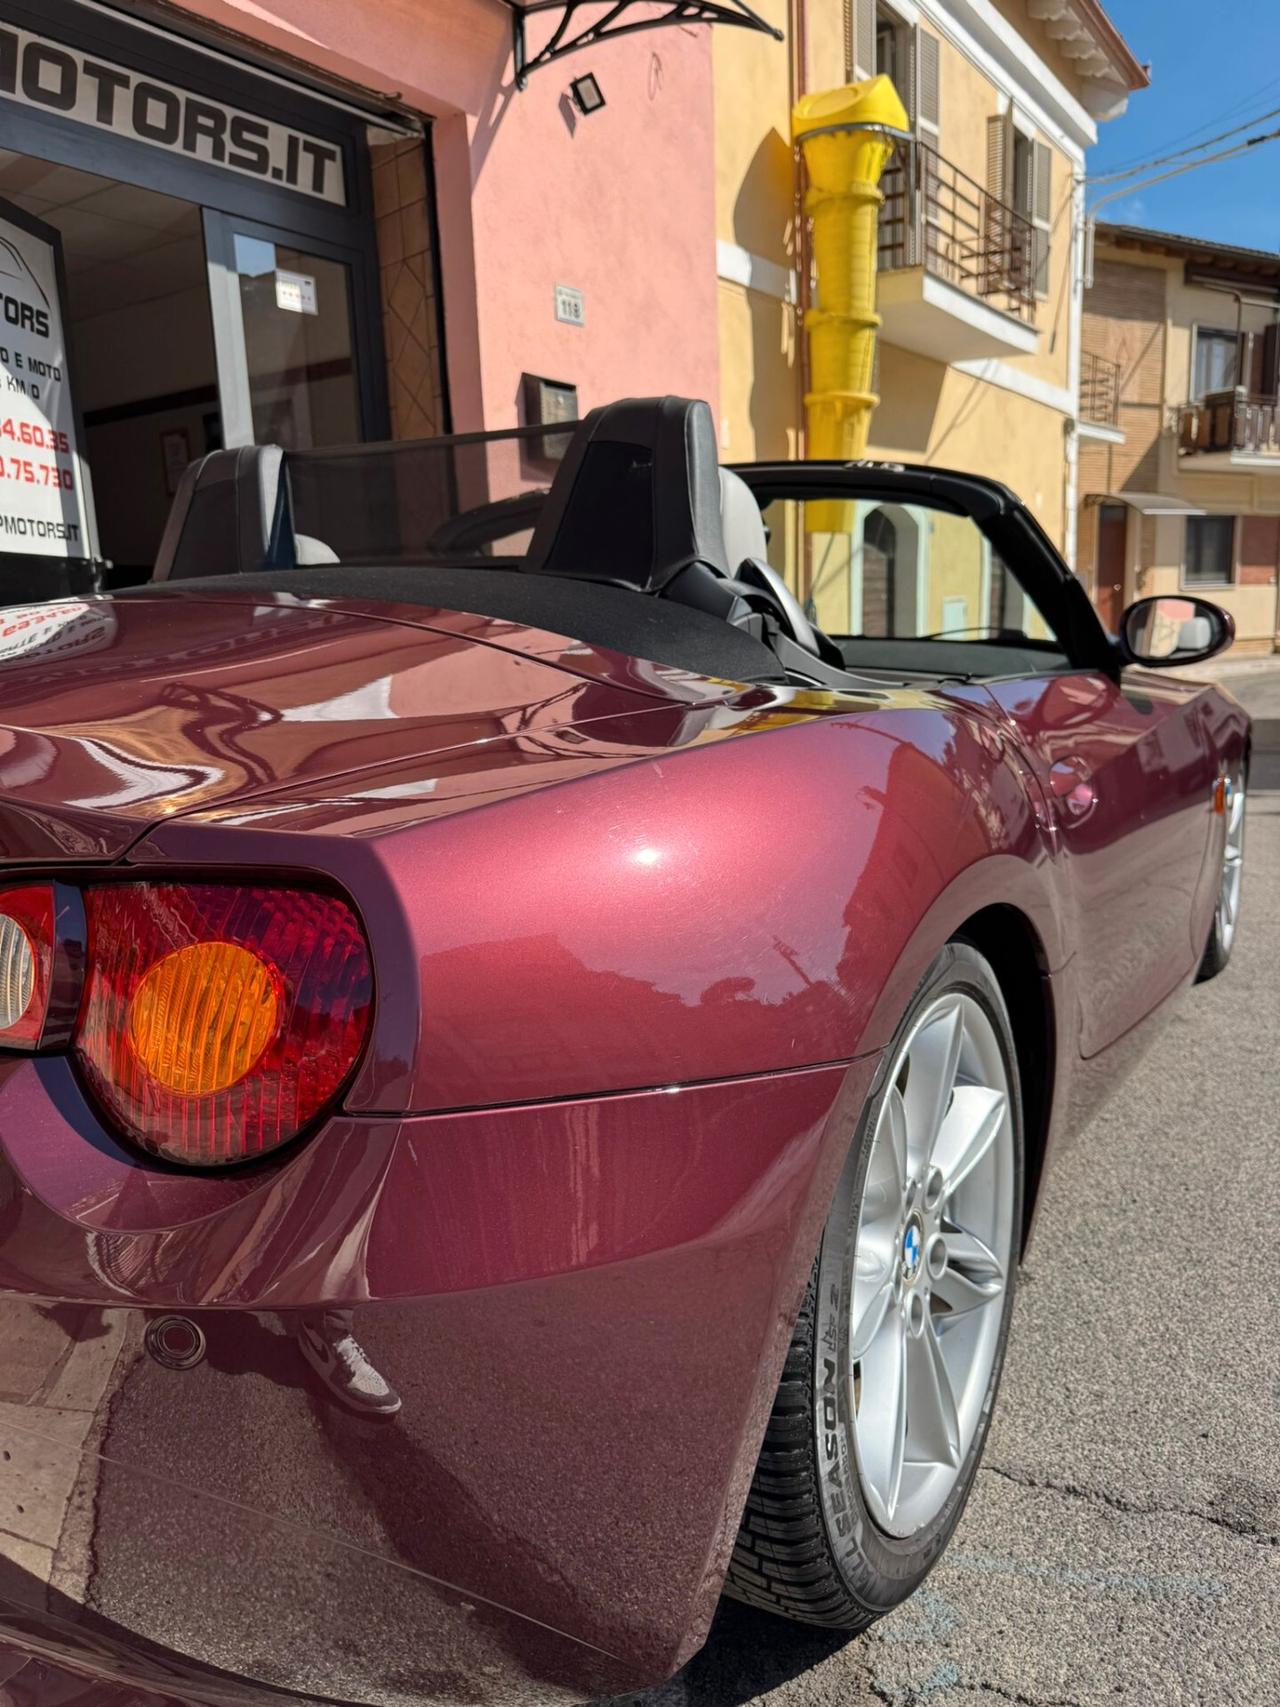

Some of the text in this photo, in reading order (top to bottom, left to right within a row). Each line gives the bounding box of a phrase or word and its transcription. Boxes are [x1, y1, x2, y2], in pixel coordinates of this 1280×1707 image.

[0, 28, 337, 195] OTORS.IT
[7, 375, 26, 395] KM
[15, 352, 23, 369] E
[28, 356, 61, 382] MOTO
[0, 417, 70, 453] 4.60.35
[823, 1358, 853, 1537] SEASON
